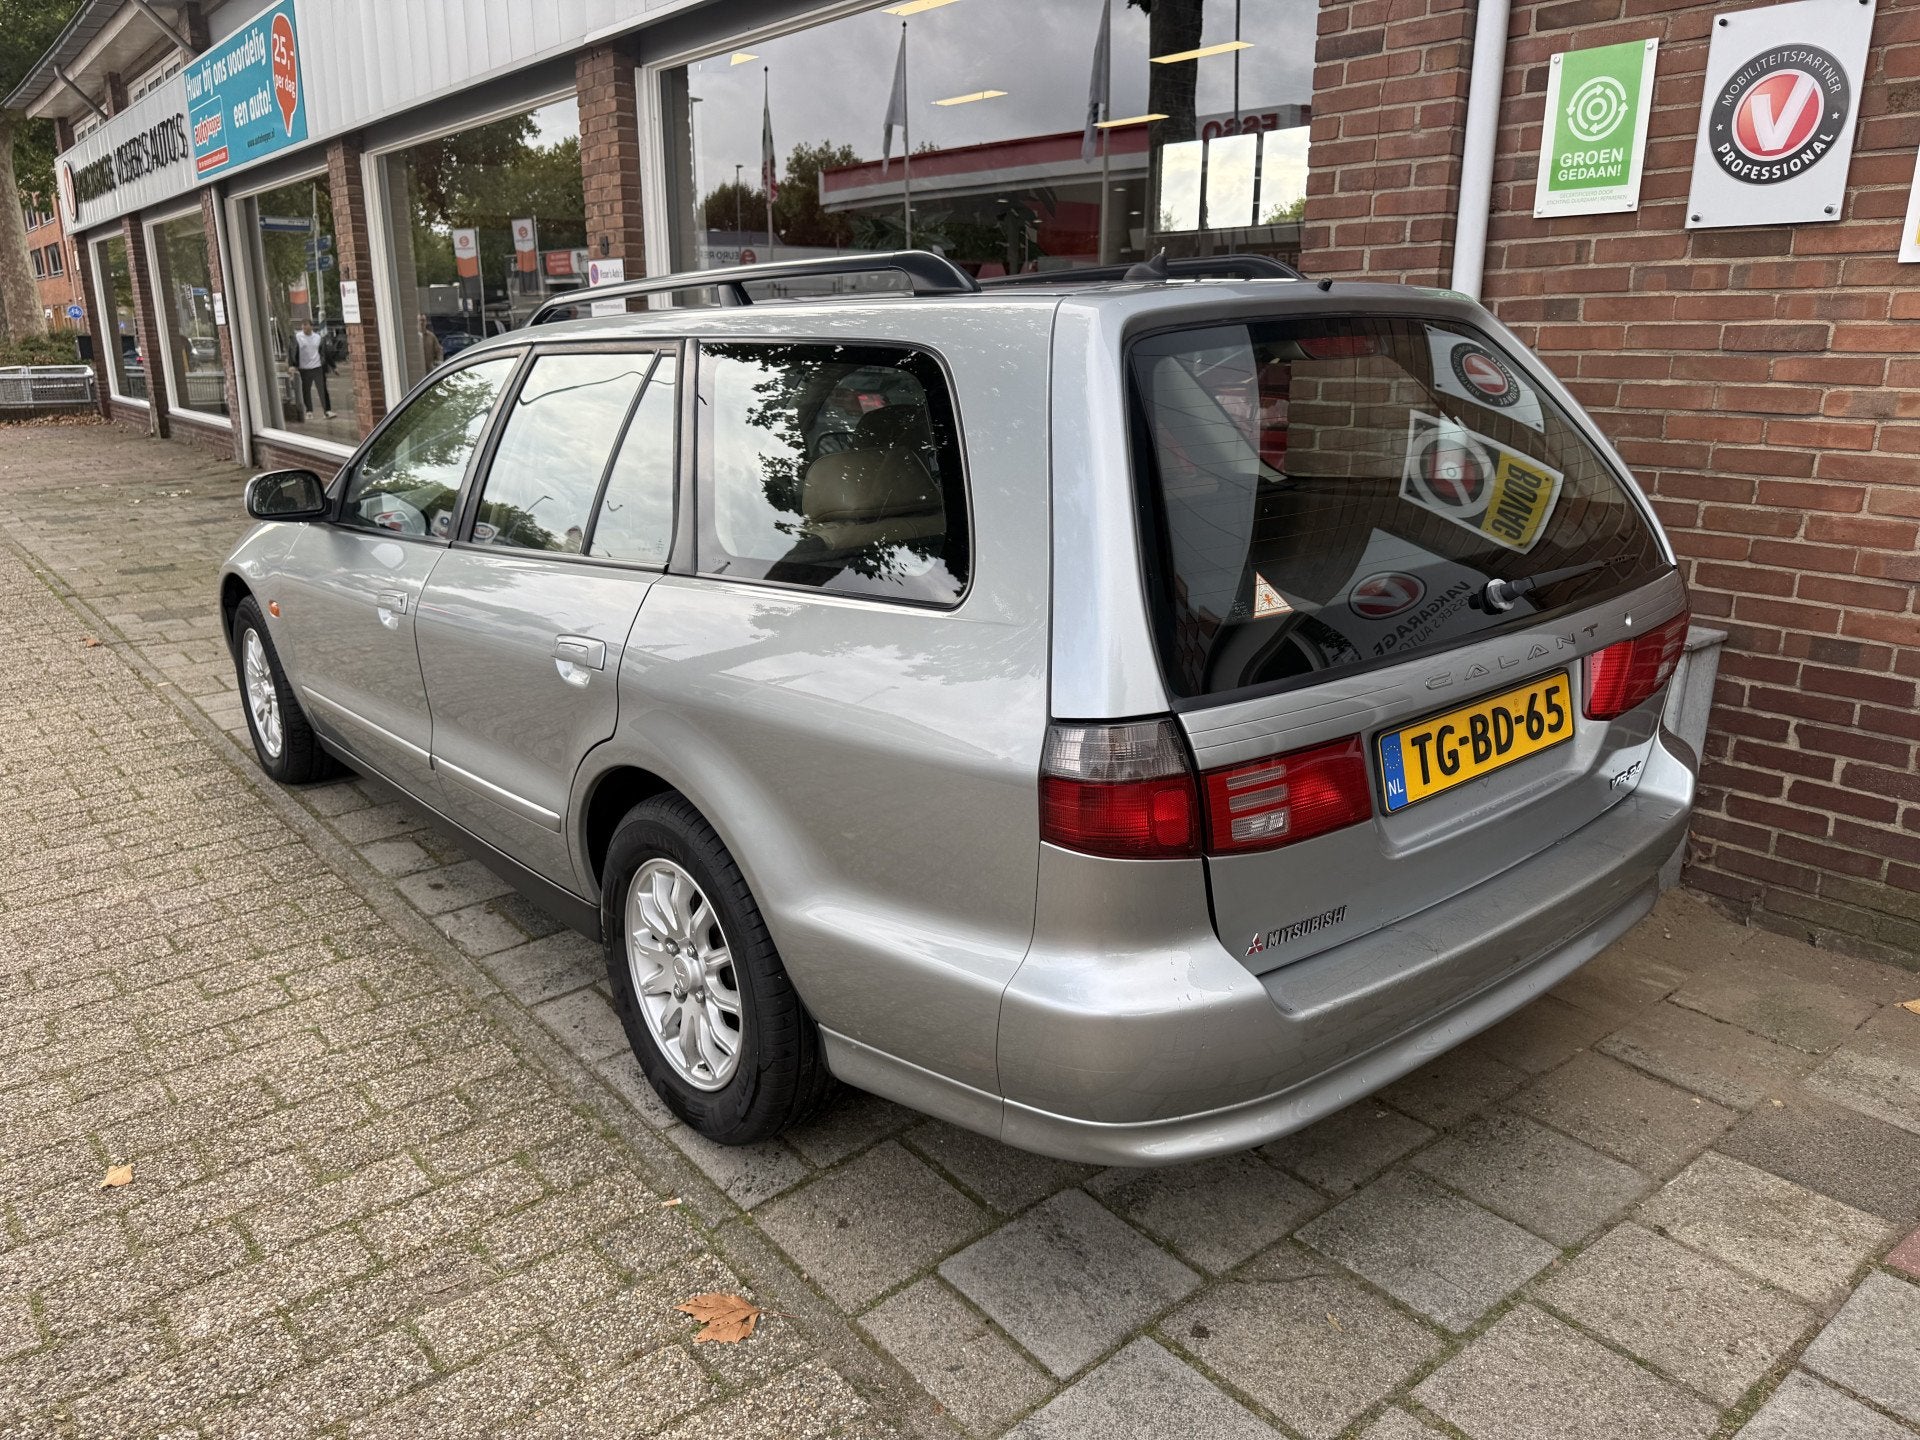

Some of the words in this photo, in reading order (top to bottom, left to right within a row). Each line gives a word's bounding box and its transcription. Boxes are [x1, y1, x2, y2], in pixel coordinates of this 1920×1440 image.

[185, 72, 202, 102] Huur
[202, 60, 214, 95] bij
[213, 57, 227, 85] ons
[227, 27, 266, 66] voordelig
[275, 74, 284, 91] per
[285, 75, 296, 98] dag
[1721, 50, 1842, 107] MOBILITEITSPARTNER
[233, 100, 249, 128] een
[249, 80, 273, 121] auto!
[113, 132, 152, 186] VISSER'S
[149, 113, 188, 167] AUTO'S
[1557, 164, 1622, 182] GEDAAN!
[1559, 148, 1624, 168] GROEN
[1717, 132, 1834, 180] PROFESSIONAL
[1424, 622, 1599, 690] GALANT
[1411, 685, 1565, 786] TG-BD-65
[1388, 778, 1404, 796] NL
[1265, 904, 1348, 950] MITSUBISHI
